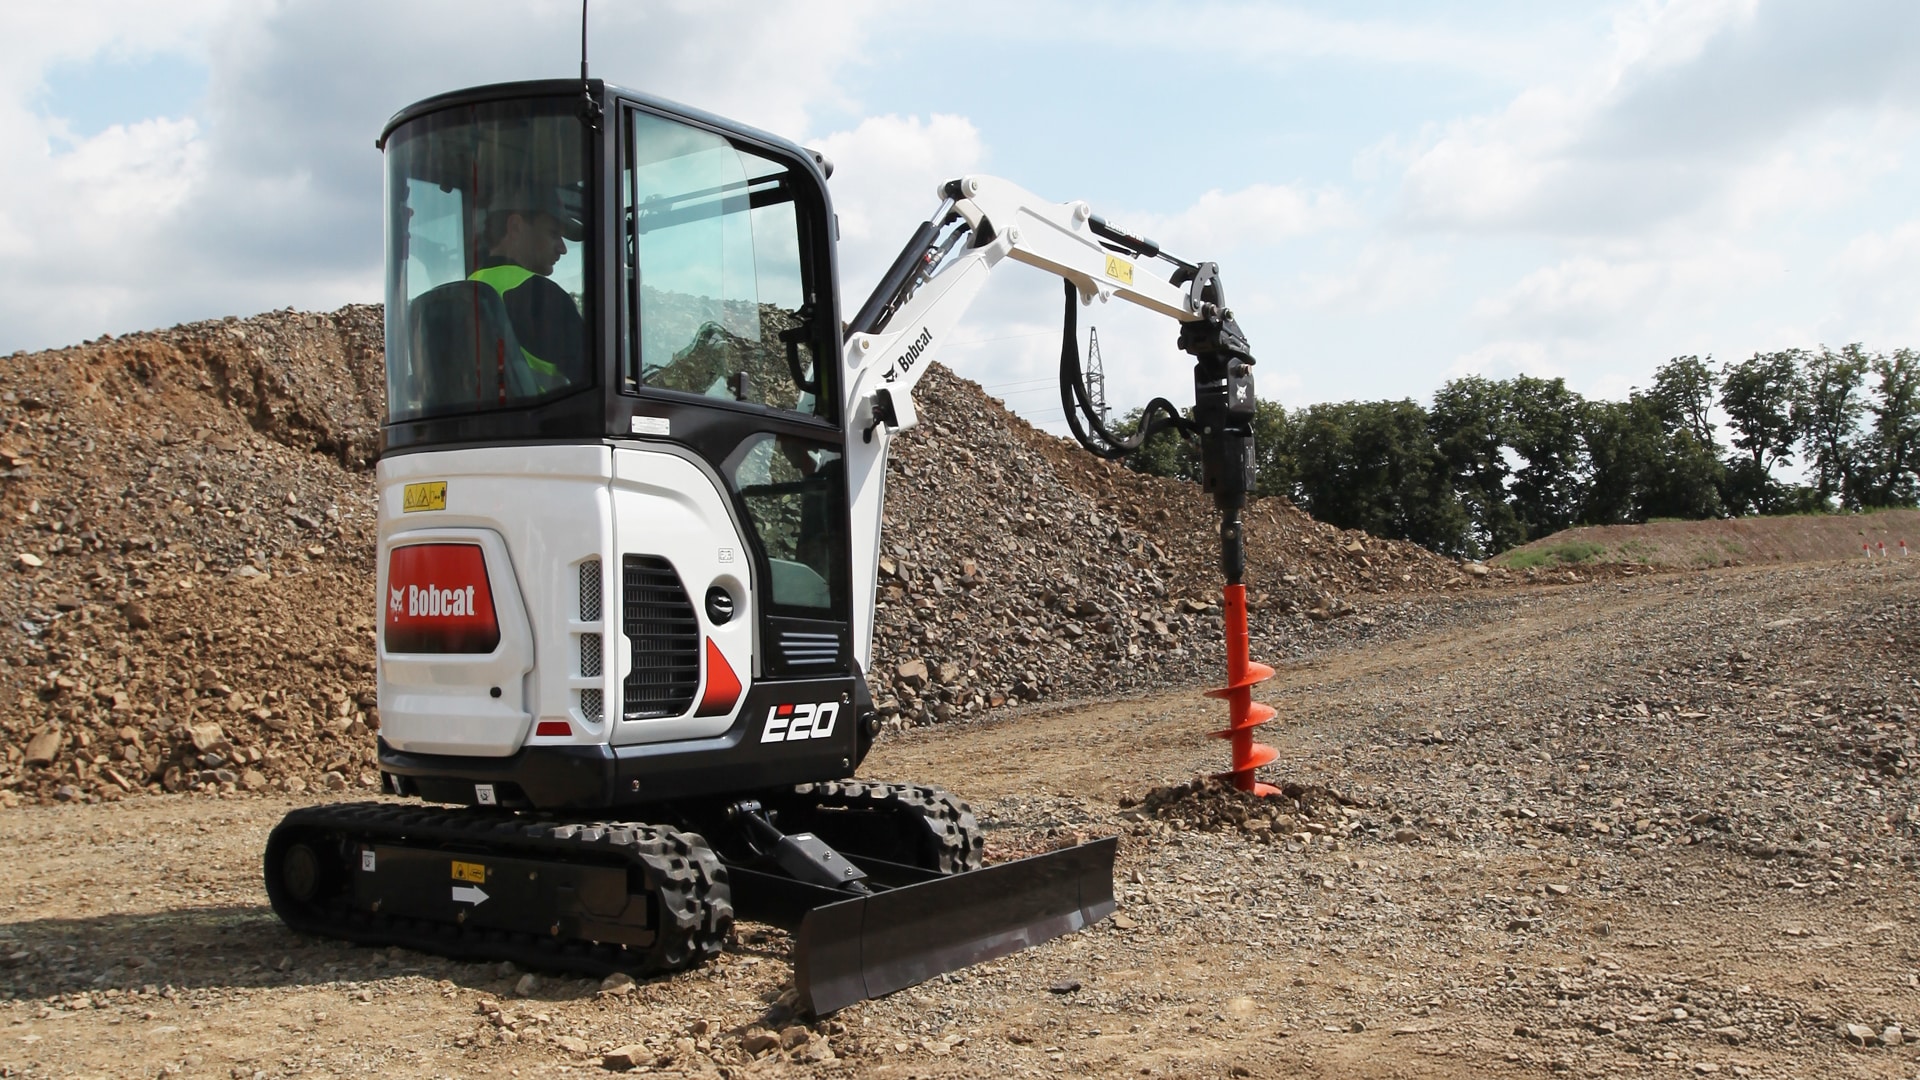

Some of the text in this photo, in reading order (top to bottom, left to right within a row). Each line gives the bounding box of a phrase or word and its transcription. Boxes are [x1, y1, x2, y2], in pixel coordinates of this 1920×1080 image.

[897, 326, 933, 373] Bobcat
[408, 583, 475, 617] Bobcat
[760, 701, 840, 744] E20
